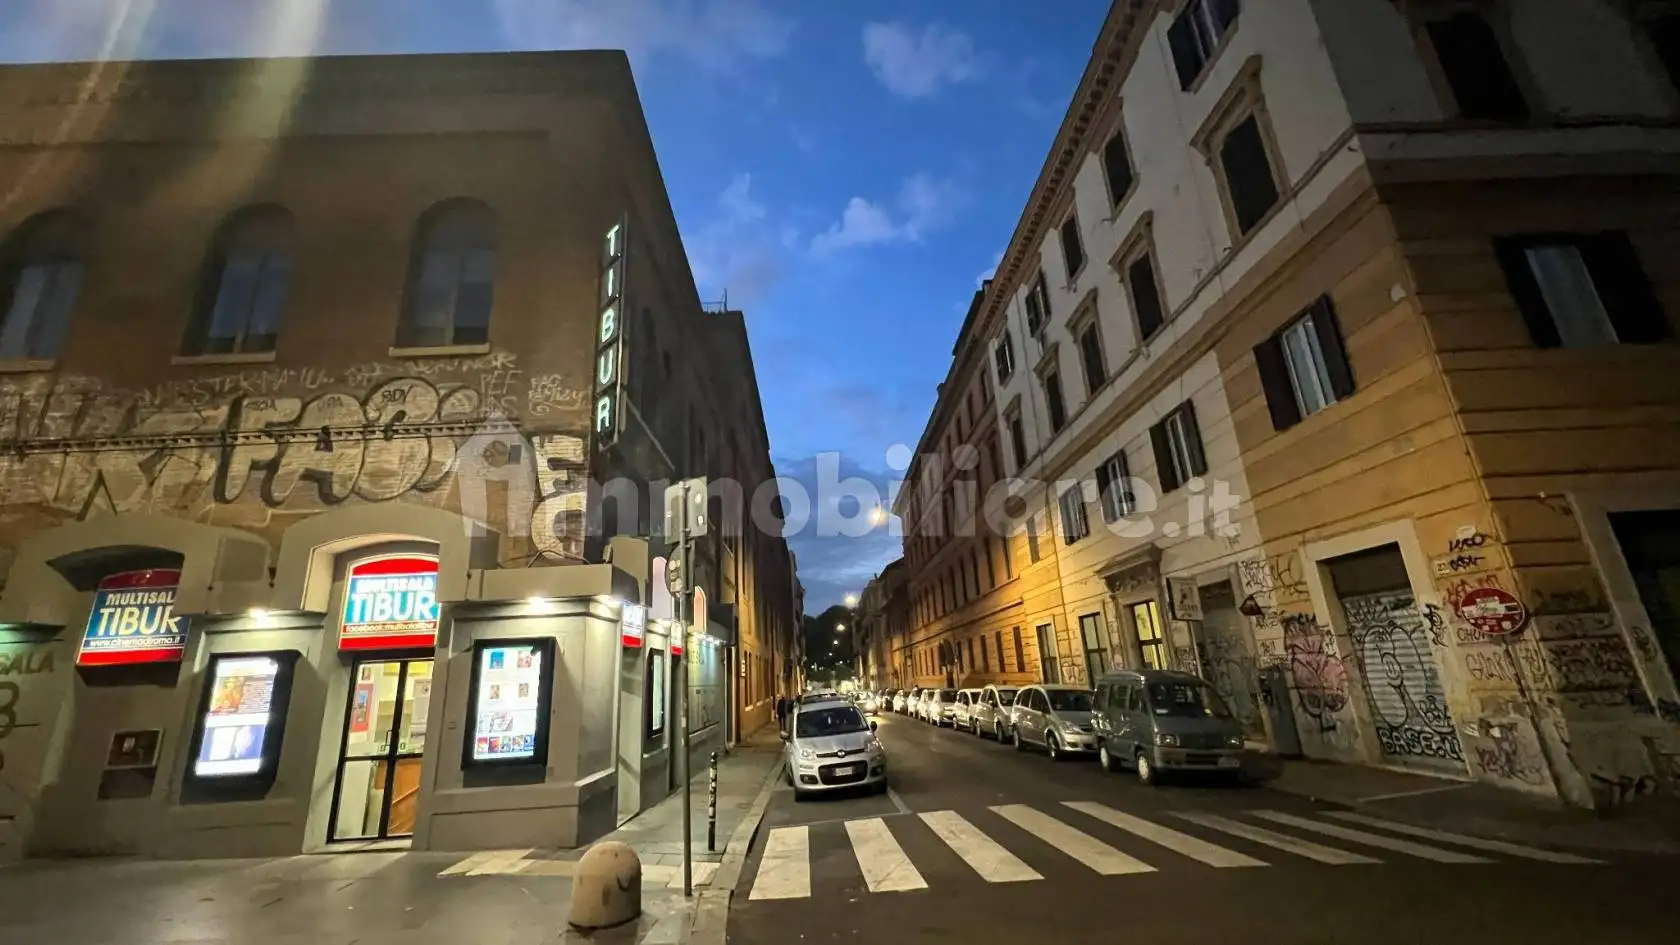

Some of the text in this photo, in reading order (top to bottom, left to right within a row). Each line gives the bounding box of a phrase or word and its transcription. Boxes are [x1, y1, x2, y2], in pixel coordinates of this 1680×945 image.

[596, 223, 621, 434] TIBUR
[105, 591, 174, 606] MULTISAL
[356, 576, 435, 593] MULTISALA
[97, 605, 182, 637] TIBUR
[348, 590, 437, 624] TIBUR
